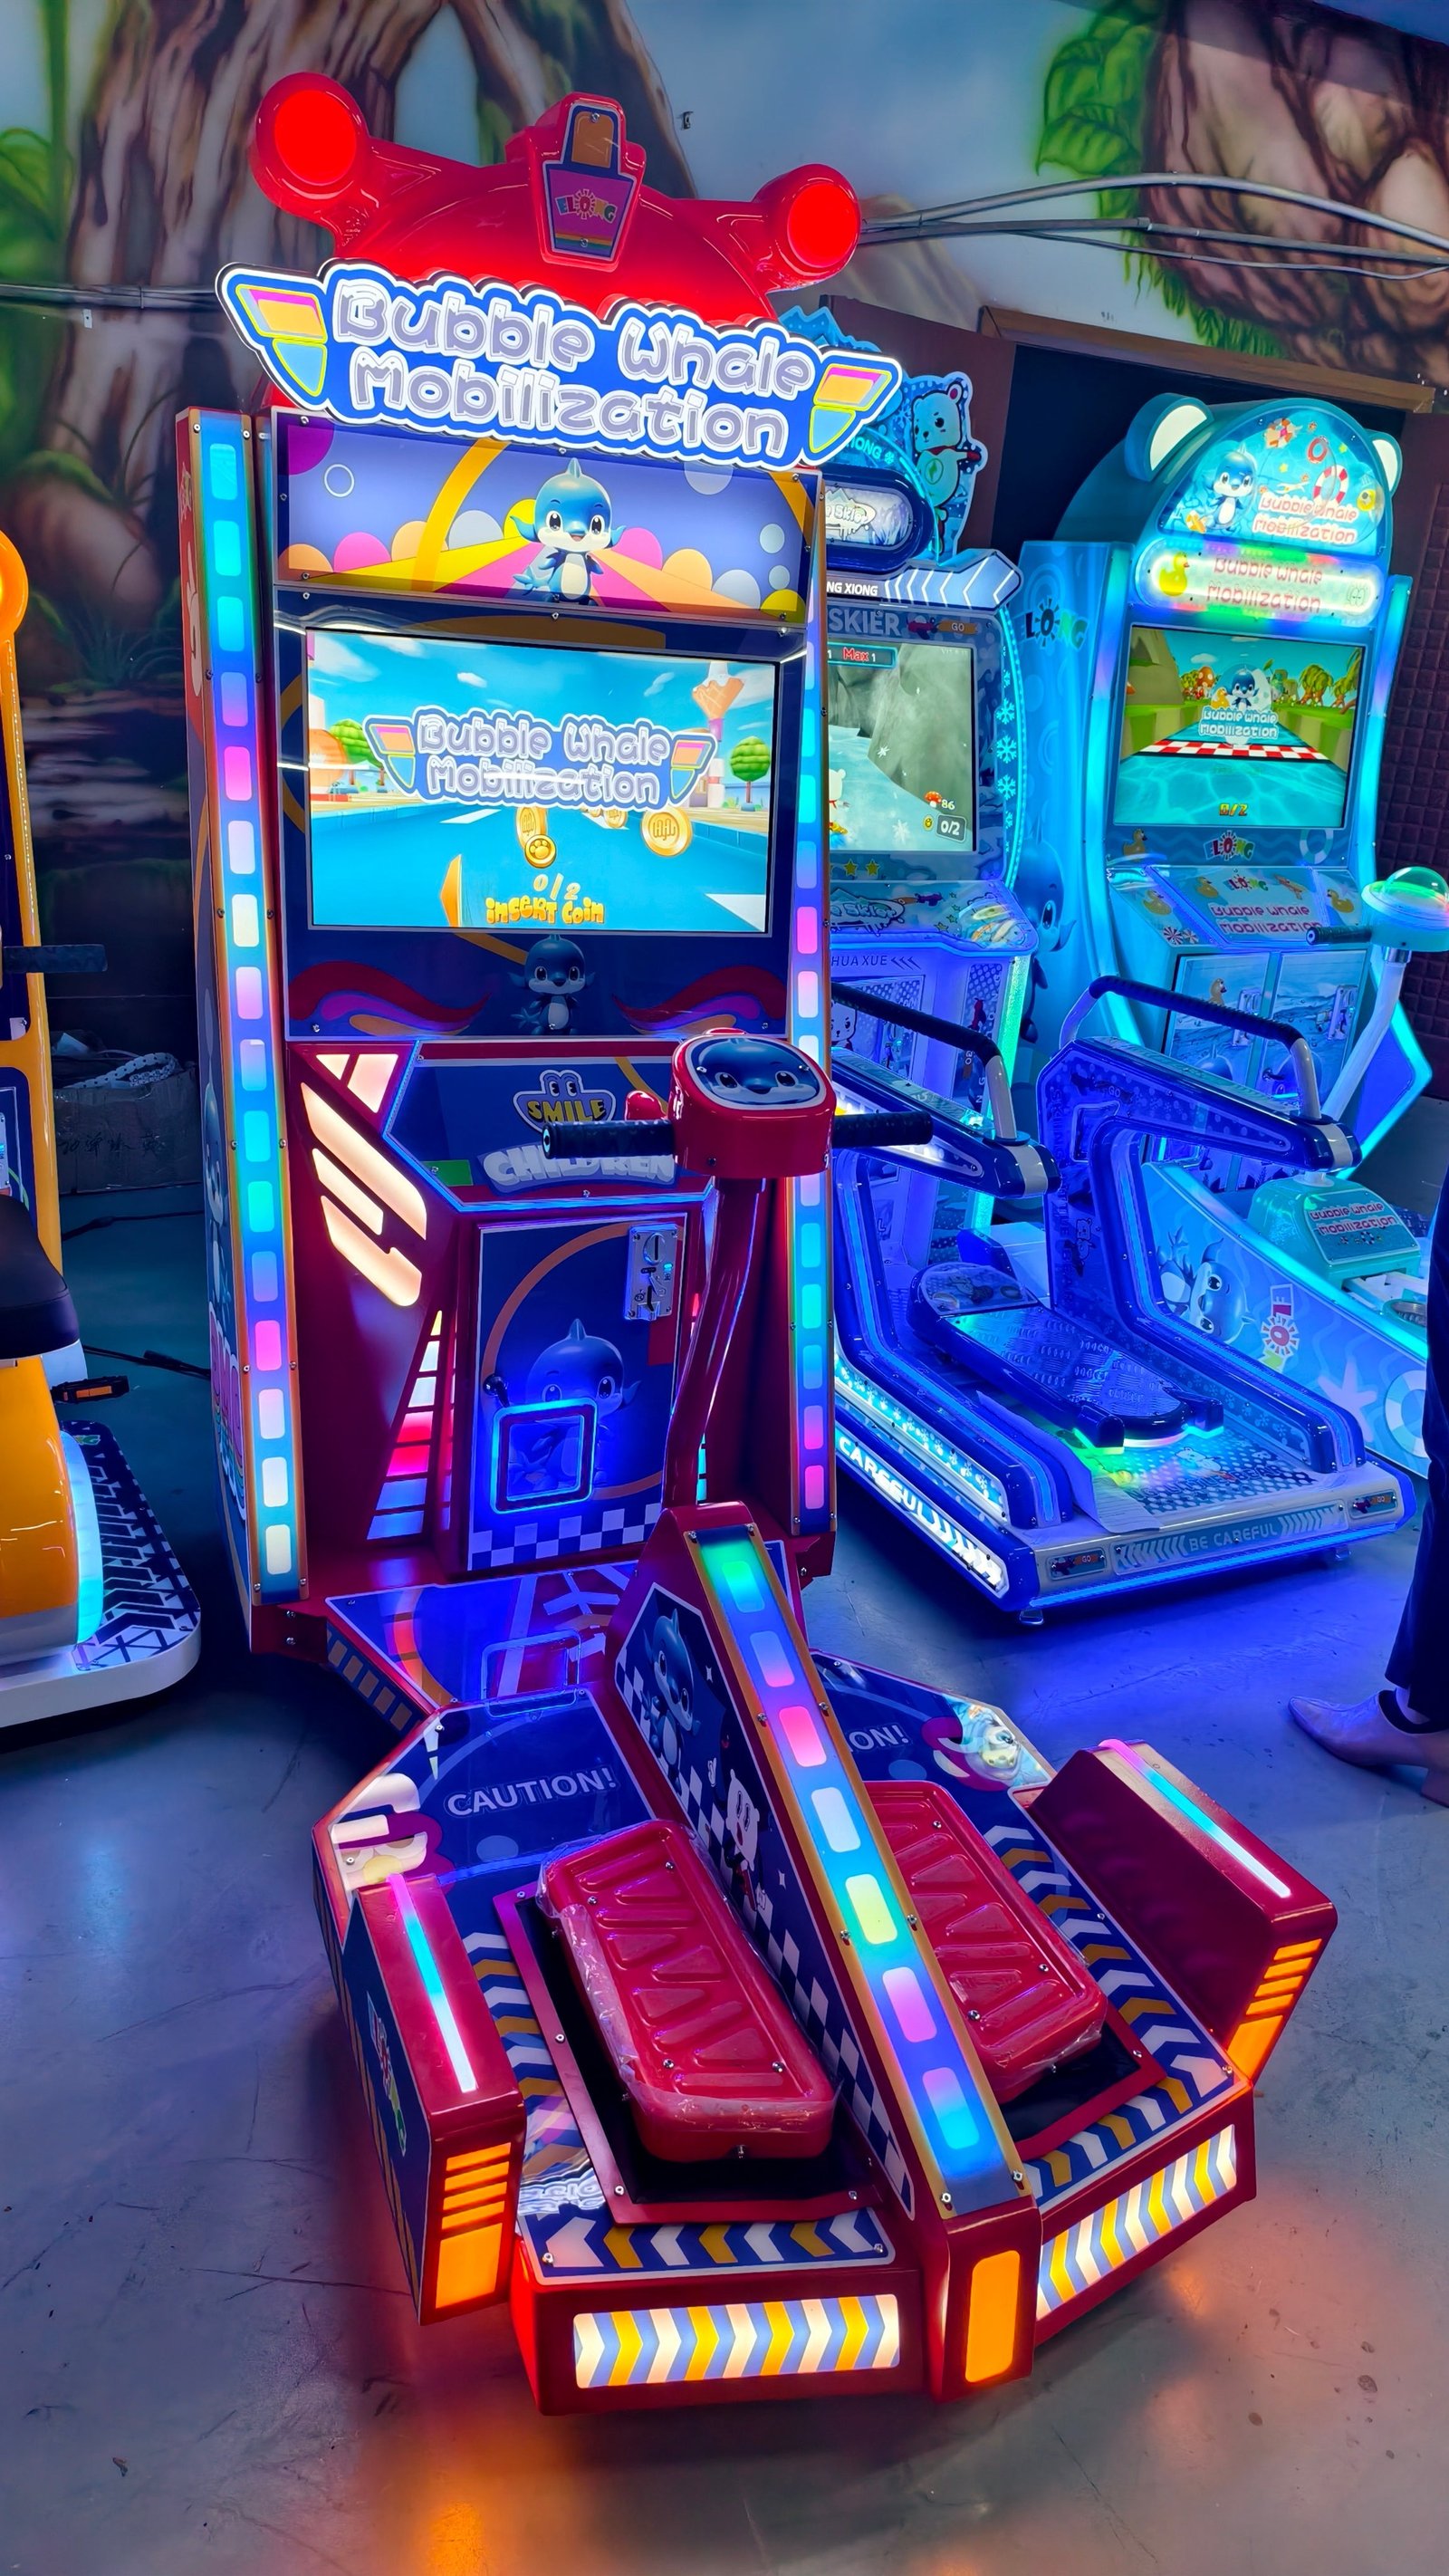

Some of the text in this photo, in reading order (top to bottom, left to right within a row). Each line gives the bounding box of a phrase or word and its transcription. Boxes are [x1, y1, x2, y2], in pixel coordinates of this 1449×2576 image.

[336, 281, 813, 399] Bubble Whale
[351, 349, 787, 457] Mobilization
[846, 437, 881, 459] IONG
[844, 582, 878, 597] XIONG
[829, 608, 901, 637] SKIER
[951, 621, 965, 632] GO
[842, 647, 869, 662] Max
[419, 715, 670, 766] Bubble Whale
[427, 756, 661, 804] Mobilization
[941, 799, 955, 811] 86
[1219, 803, 1249, 816] 0/2
[940, 820, 961, 836] 0/2
[527, 1099, 607, 1122] SMILE
[839, 1437, 934, 1525] CAREFUL
[1188, 1523, 1279, 1552] BE CAREFUL
[446, 1767, 617, 1816] CAUTION!
